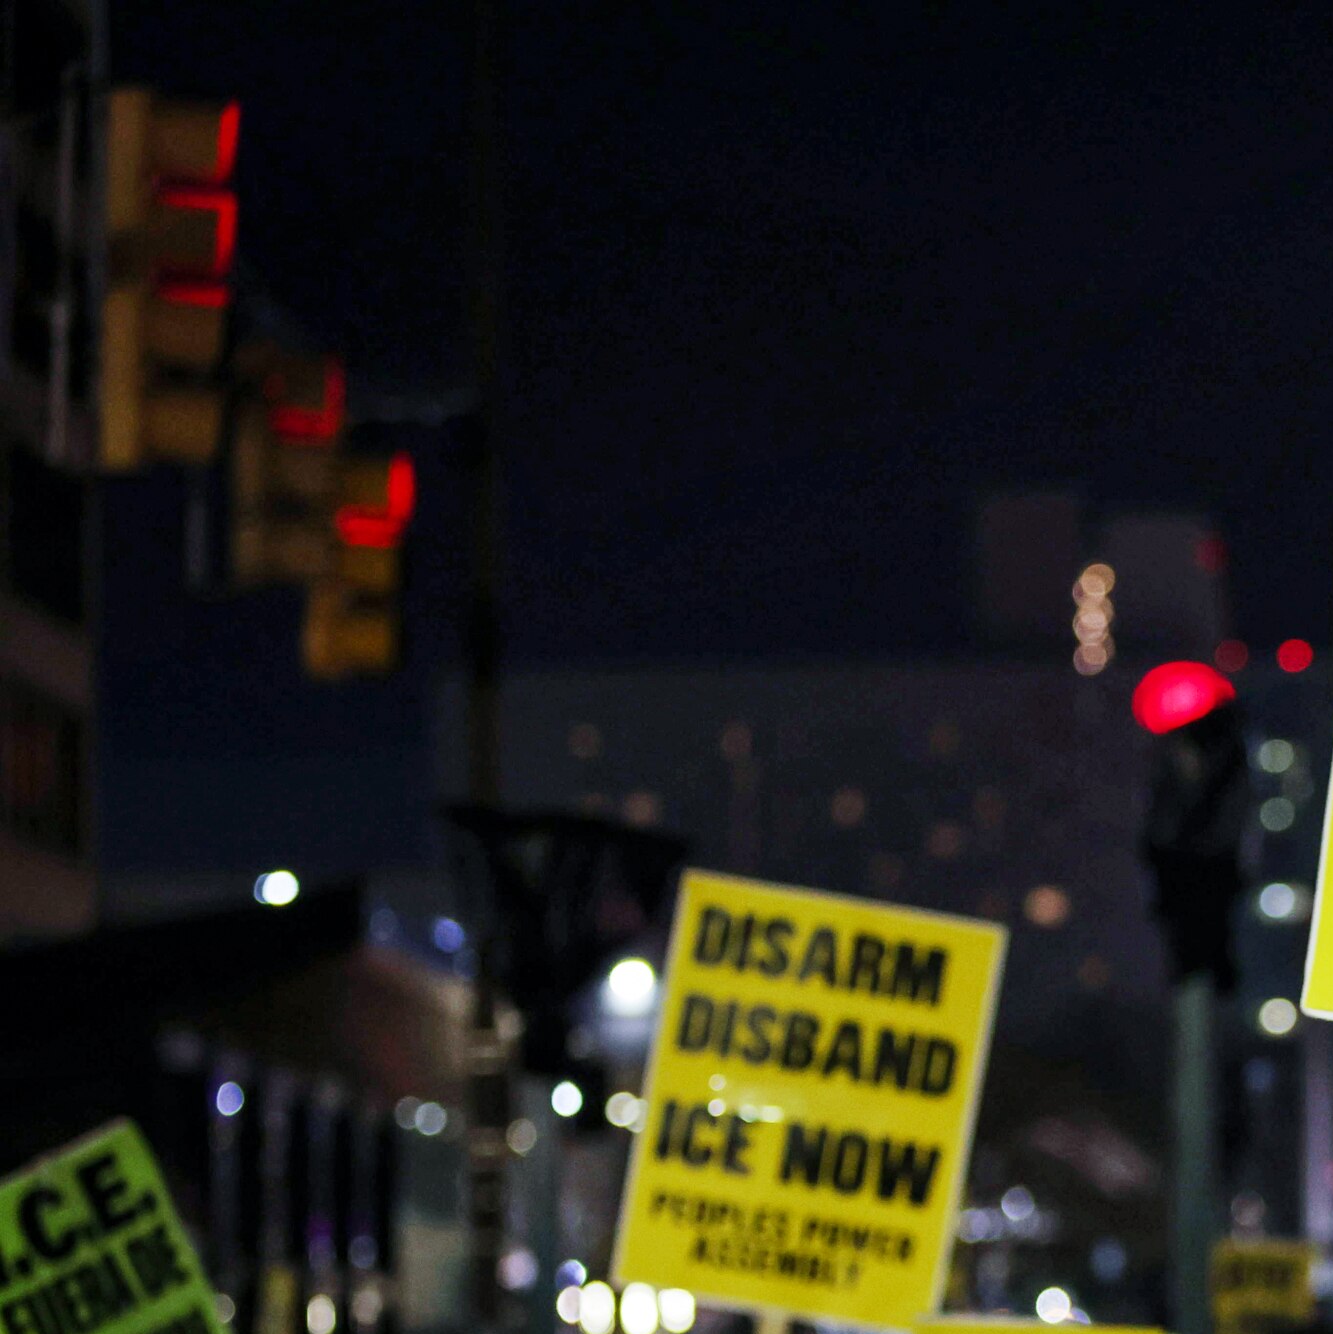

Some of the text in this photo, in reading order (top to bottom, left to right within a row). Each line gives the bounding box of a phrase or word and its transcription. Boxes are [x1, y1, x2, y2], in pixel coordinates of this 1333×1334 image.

[691, 905, 949, 1008] DISARM
[676, 993, 959, 1097] DISBAND
[655, 1100, 942, 1208] ICE NOW
